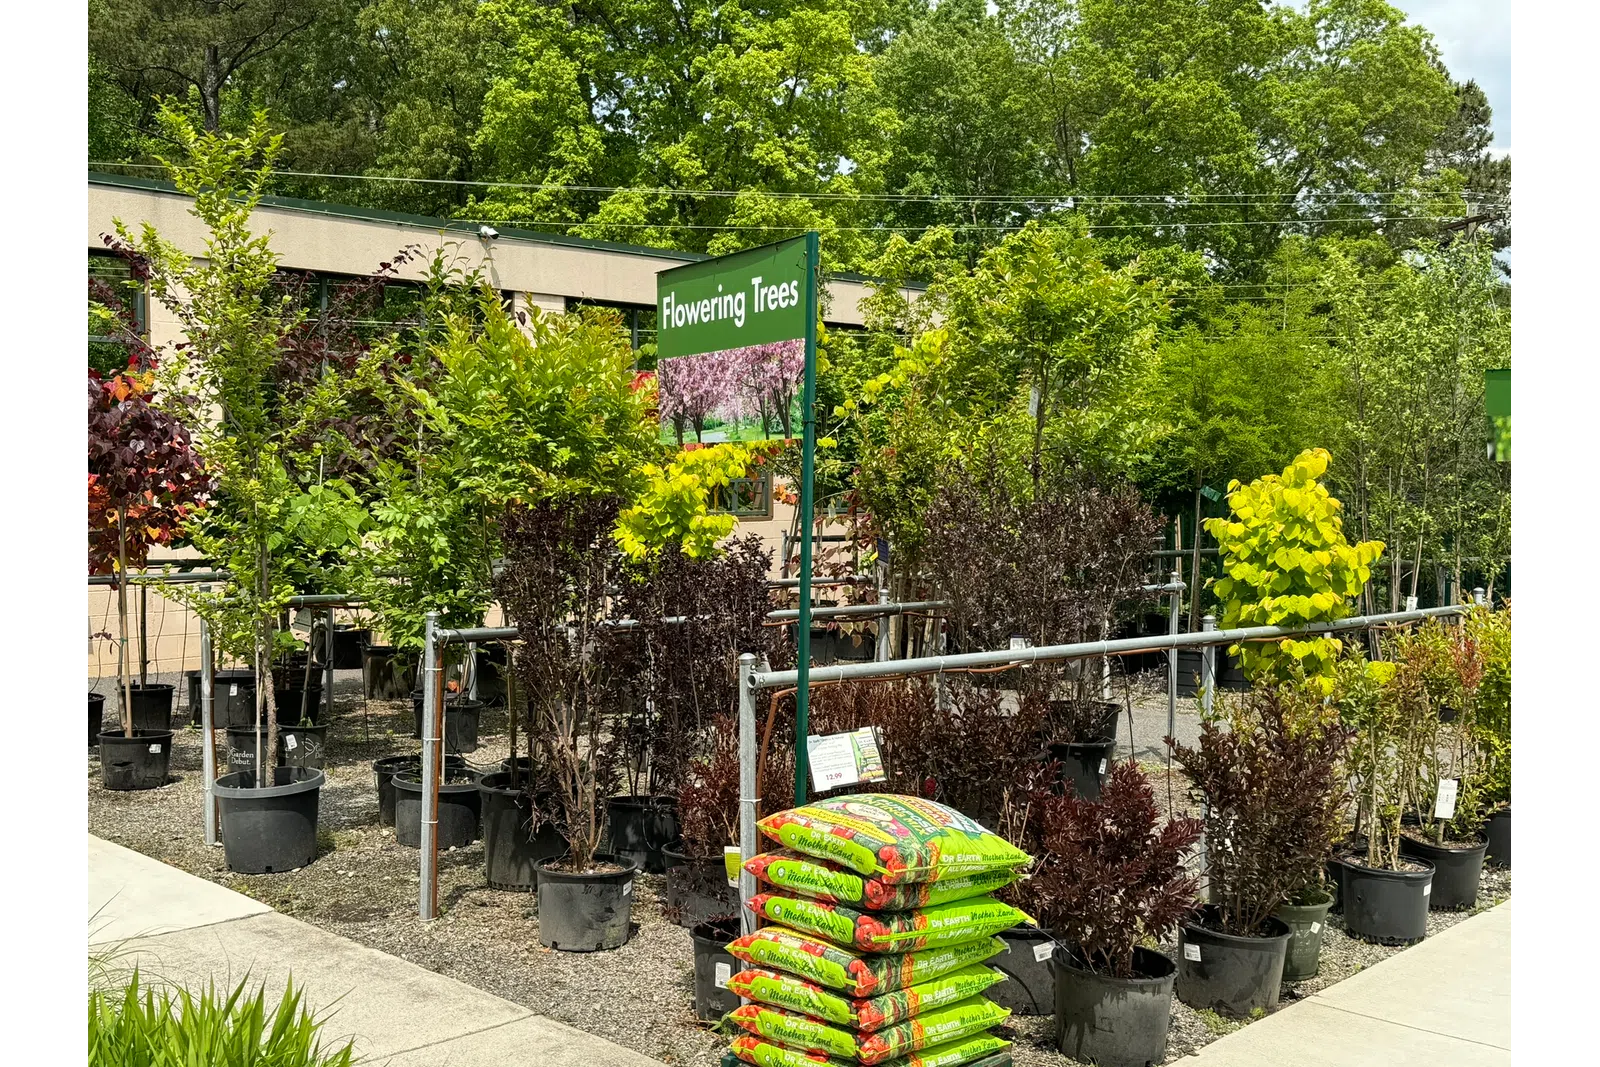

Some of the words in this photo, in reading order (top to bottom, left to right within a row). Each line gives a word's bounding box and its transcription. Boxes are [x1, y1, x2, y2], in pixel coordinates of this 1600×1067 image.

[663, 284, 745, 329] Flowering
[751, 276, 799, 313] Trees
[231, 751, 254, 759] Garden
[826, 772, 843, 781] 12.99
[798, 835, 828, 854] Mother
[829, 843, 855, 861] Land
[956, 853, 981, 862] EARTH
[981, 852, 1005, 861] Mother
[788, 869, 818, 886] Mother
[783, 907, 813, 925] Mother
[944, 915, 970, 926] EARTH
[971, 911, 995, 921] Mother
[996, 908, 1015, 918] Land
[767, 950, 800, 968] Mother
[800, 960, 826, 980] Land
[929, 953, 953, 965] EARTH
[769, 988, 801, 1006] Mother
[799, 1022, 825, 1034] EARTH
[936, 1020, 961, 1032] EARTH
[773, 1023, 806, 1042] Mother
[807, 1031, 833, 1047] Land
[937, 1053, 960, 1065] EARTH
